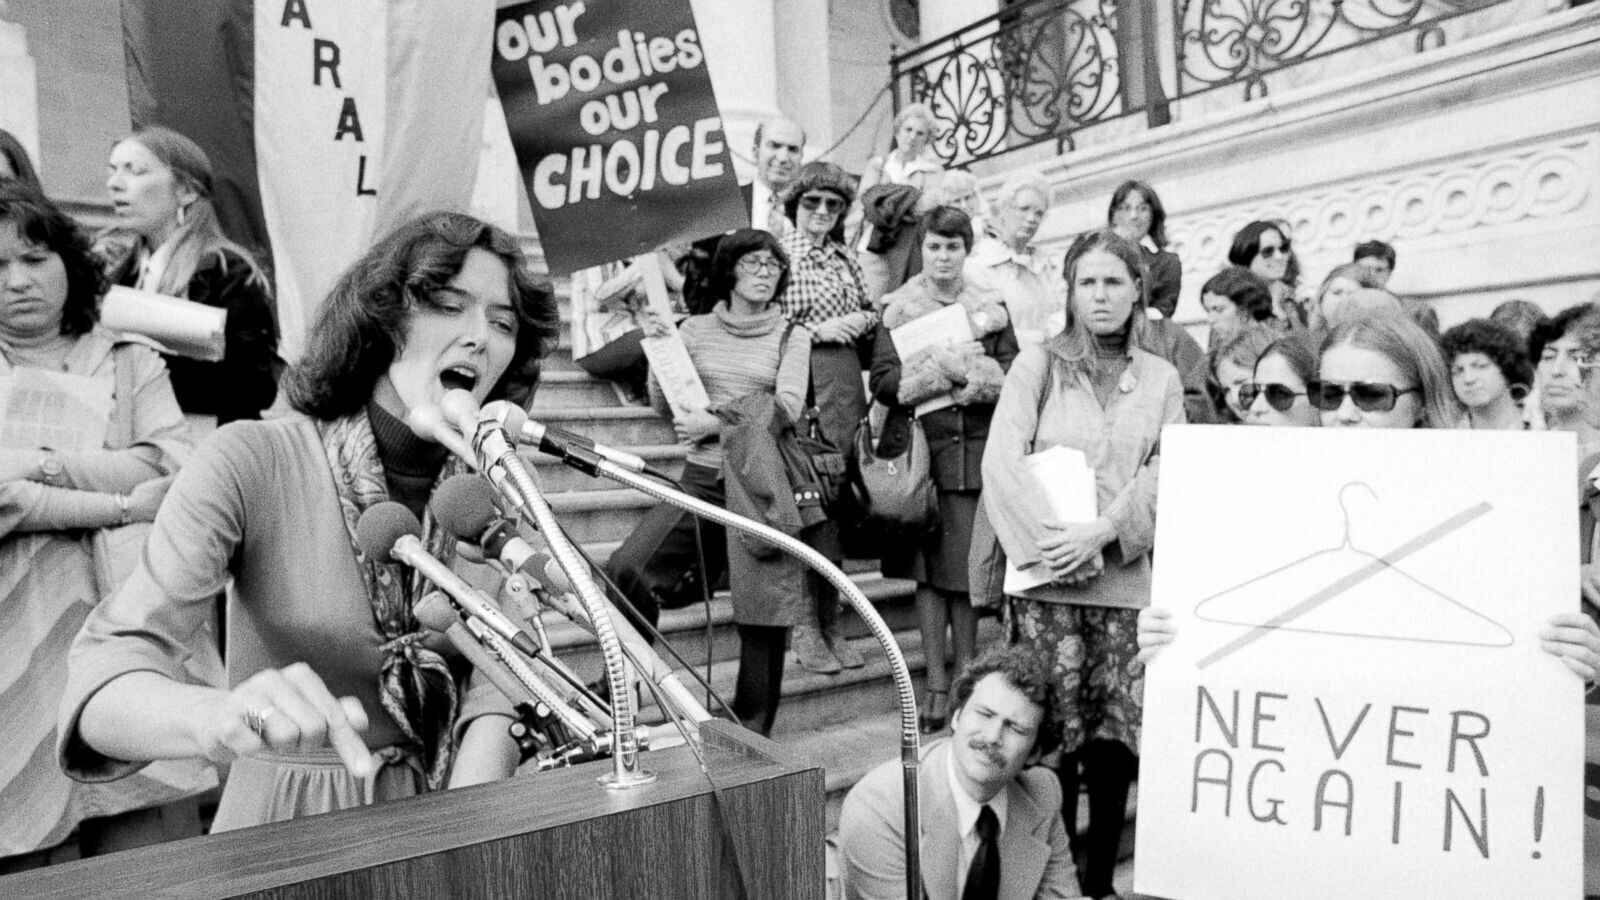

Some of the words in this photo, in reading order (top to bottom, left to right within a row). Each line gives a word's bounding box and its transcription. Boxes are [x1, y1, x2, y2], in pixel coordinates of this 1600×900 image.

[498, 2, 586, 60] our
[528, 29, 702, 105] bodies
[580, 82, 668, 135] our
[533, 118, 723, 209] CHOICE
[1195, 685, 1491, 776] NEVER
